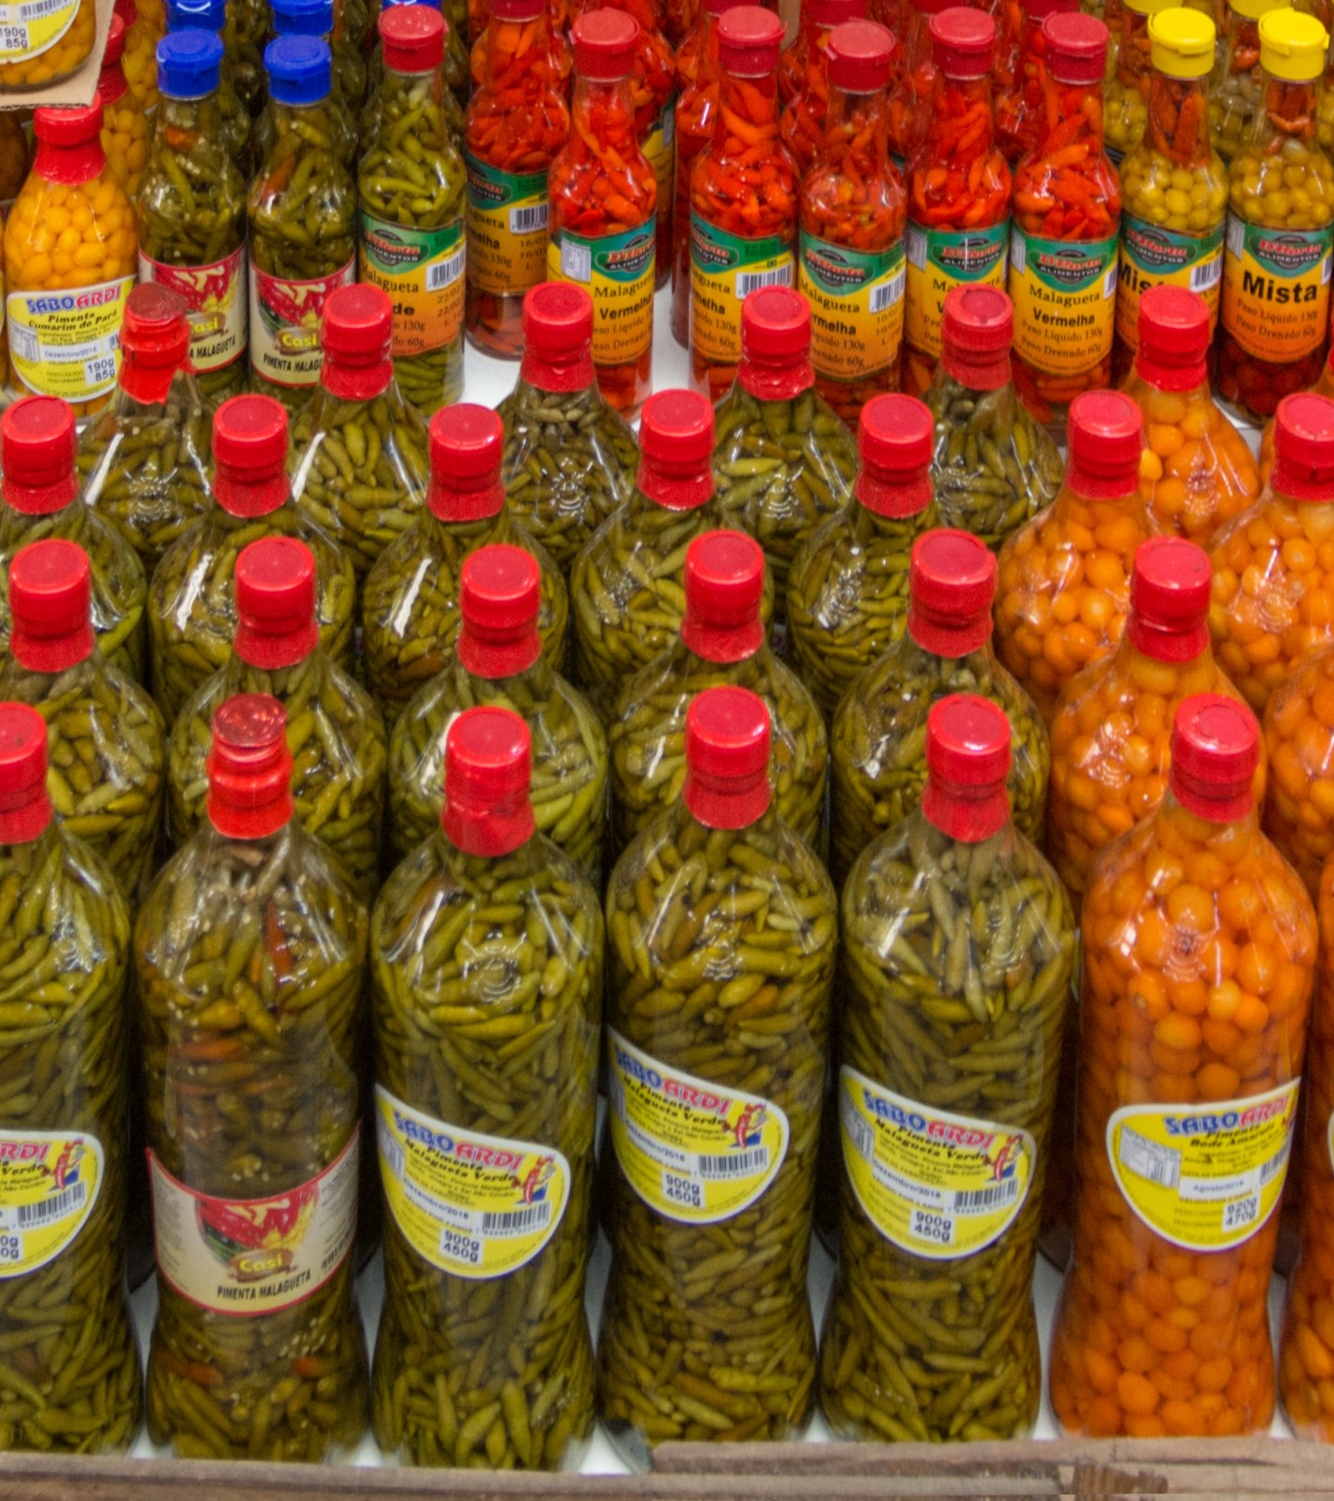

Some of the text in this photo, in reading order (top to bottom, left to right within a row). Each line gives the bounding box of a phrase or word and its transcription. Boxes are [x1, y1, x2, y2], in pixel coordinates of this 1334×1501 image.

[1028, 285, 1101, 307] Malagueta
[1241, 270, 1319, 304] Mista
[27, 286, 123, 315] SABOARDI
[48, 311, 96, 326] Pimenta
[1032, 307, 1096, 327] Vermelha
[86, 358, 115, 374] 190g
[217, 1271, 312, 1300] PIMENTA MALAGUETA
